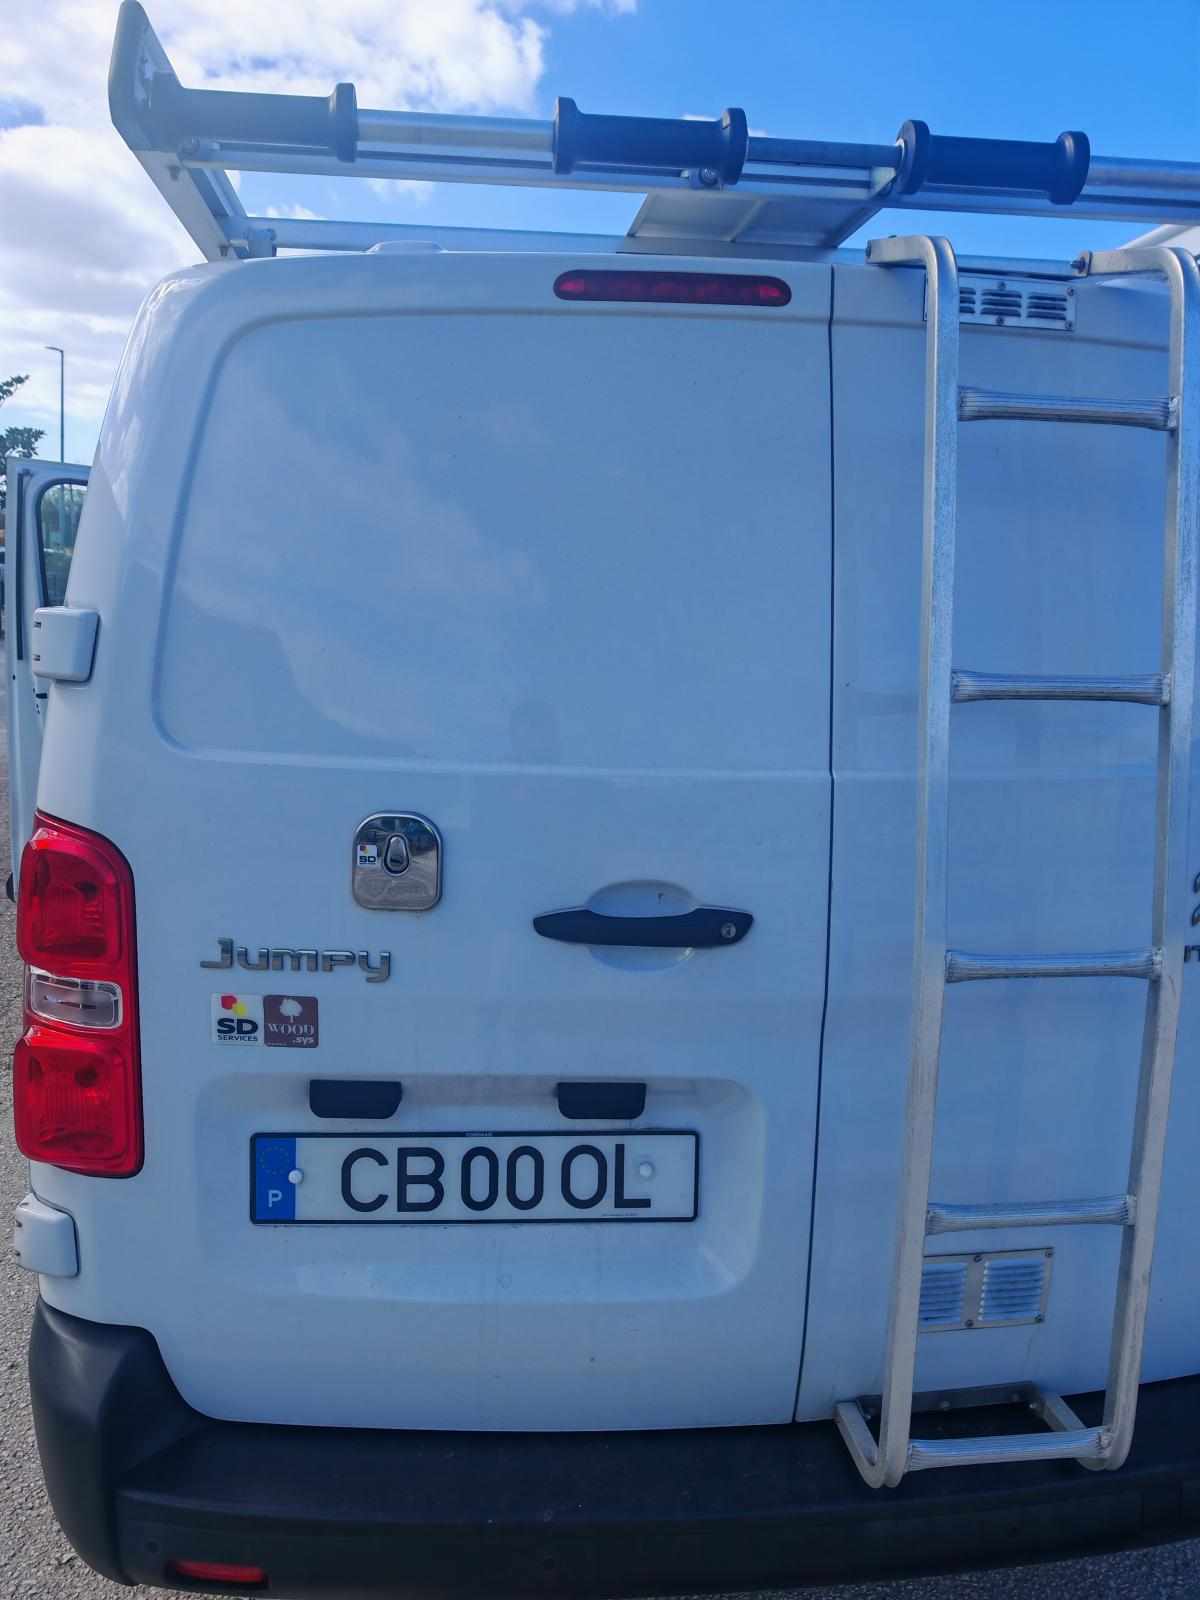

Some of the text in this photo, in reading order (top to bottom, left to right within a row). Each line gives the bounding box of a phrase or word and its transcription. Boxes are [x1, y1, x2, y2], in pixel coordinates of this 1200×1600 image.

[200, 937, 392, 983] Jumpy
[217, 1018, 259, 1035] SD
[217, 1034, 259, 1042] SERVICES
[268, 1190, 282, 1208] P
